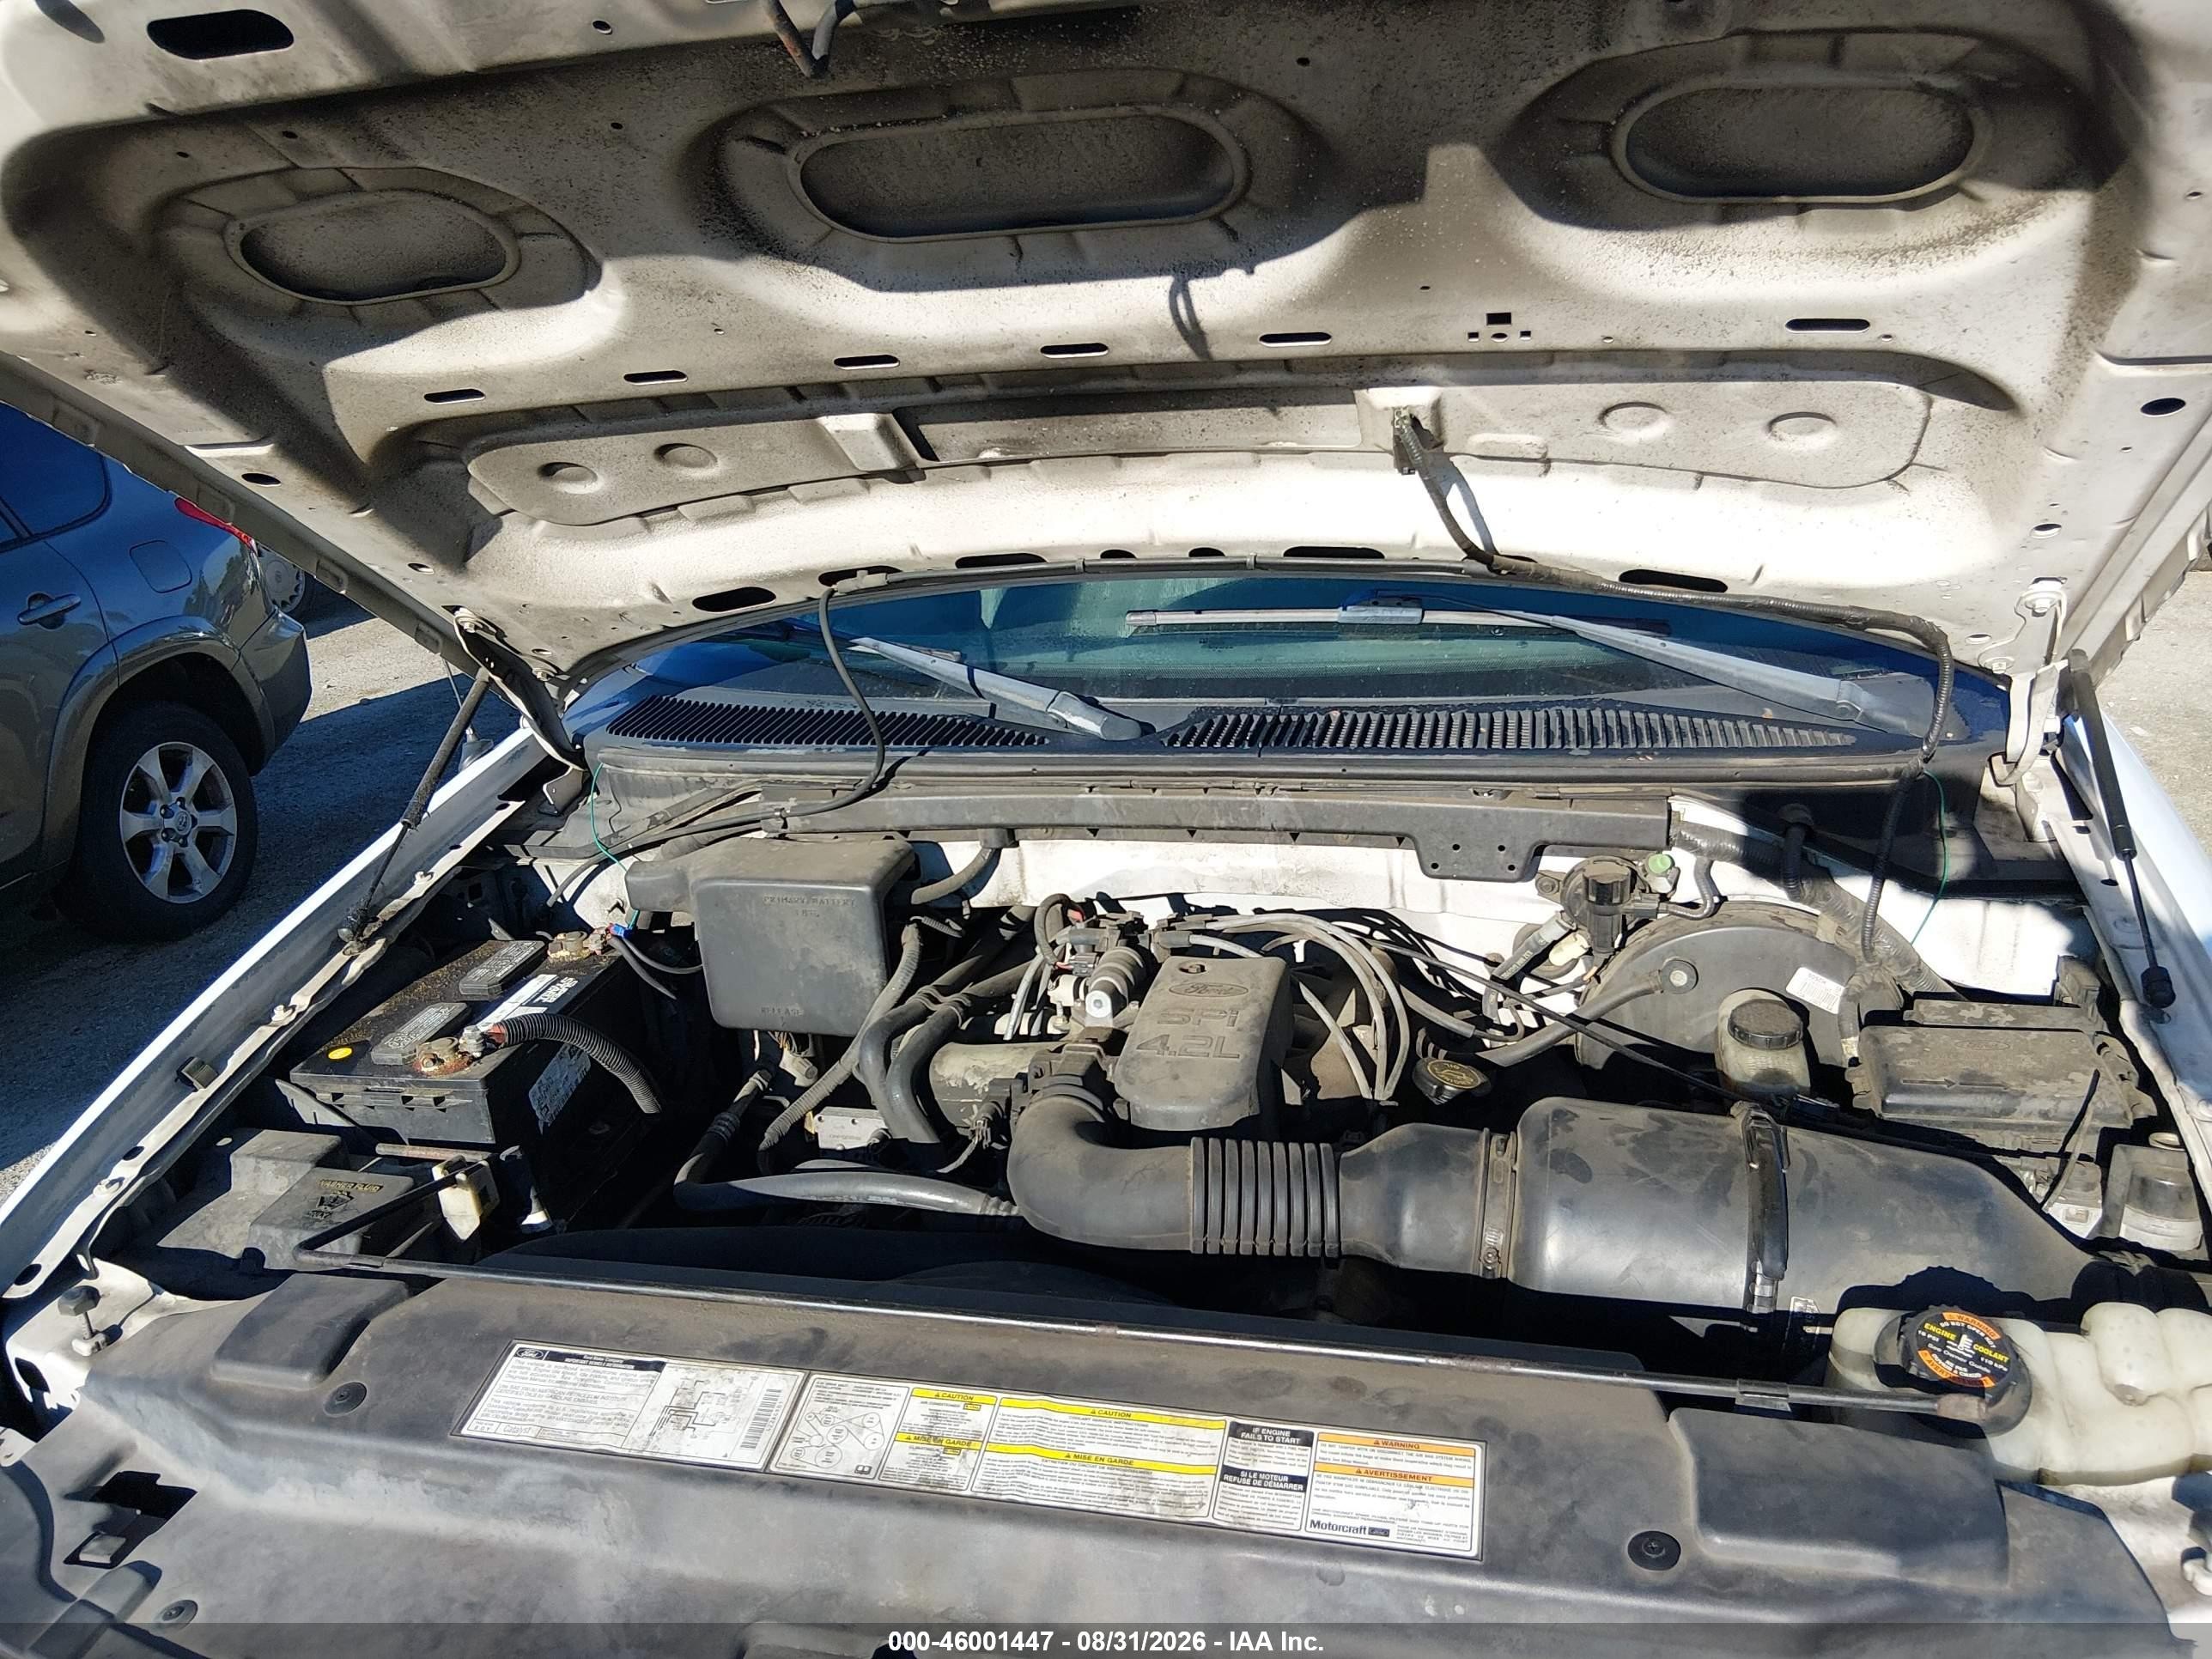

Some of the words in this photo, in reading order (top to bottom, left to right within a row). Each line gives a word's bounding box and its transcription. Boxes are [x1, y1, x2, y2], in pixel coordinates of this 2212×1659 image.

[1185, 982, 1234, 994] Ford
[1136, 1034, 1240, 1059] 4.2L
[1923, 1322, 1957, 1340] ENGINE
[1958, 1315, 1996, 1338] WARNING
[1973, 1343, 2009, 1363] COOLANT
[941, 1392, 975, 1401] CAUTION
[1261, 1428, 1291, 1437] ENGINE
[914, 1434, 933, 1443] MISE
[945, 1437, 972, 1447] GARDE
[1275, 1436, 1301, 1444] START
[1381, 1441, 1420, 1449] WARNING
[1224, 1474, 1251, 1485] REFUSE
[1363, 1468, 1433, 1482] AVERTISSEMENT
[1310, 1519, 1367, 1534] Motorcraft
